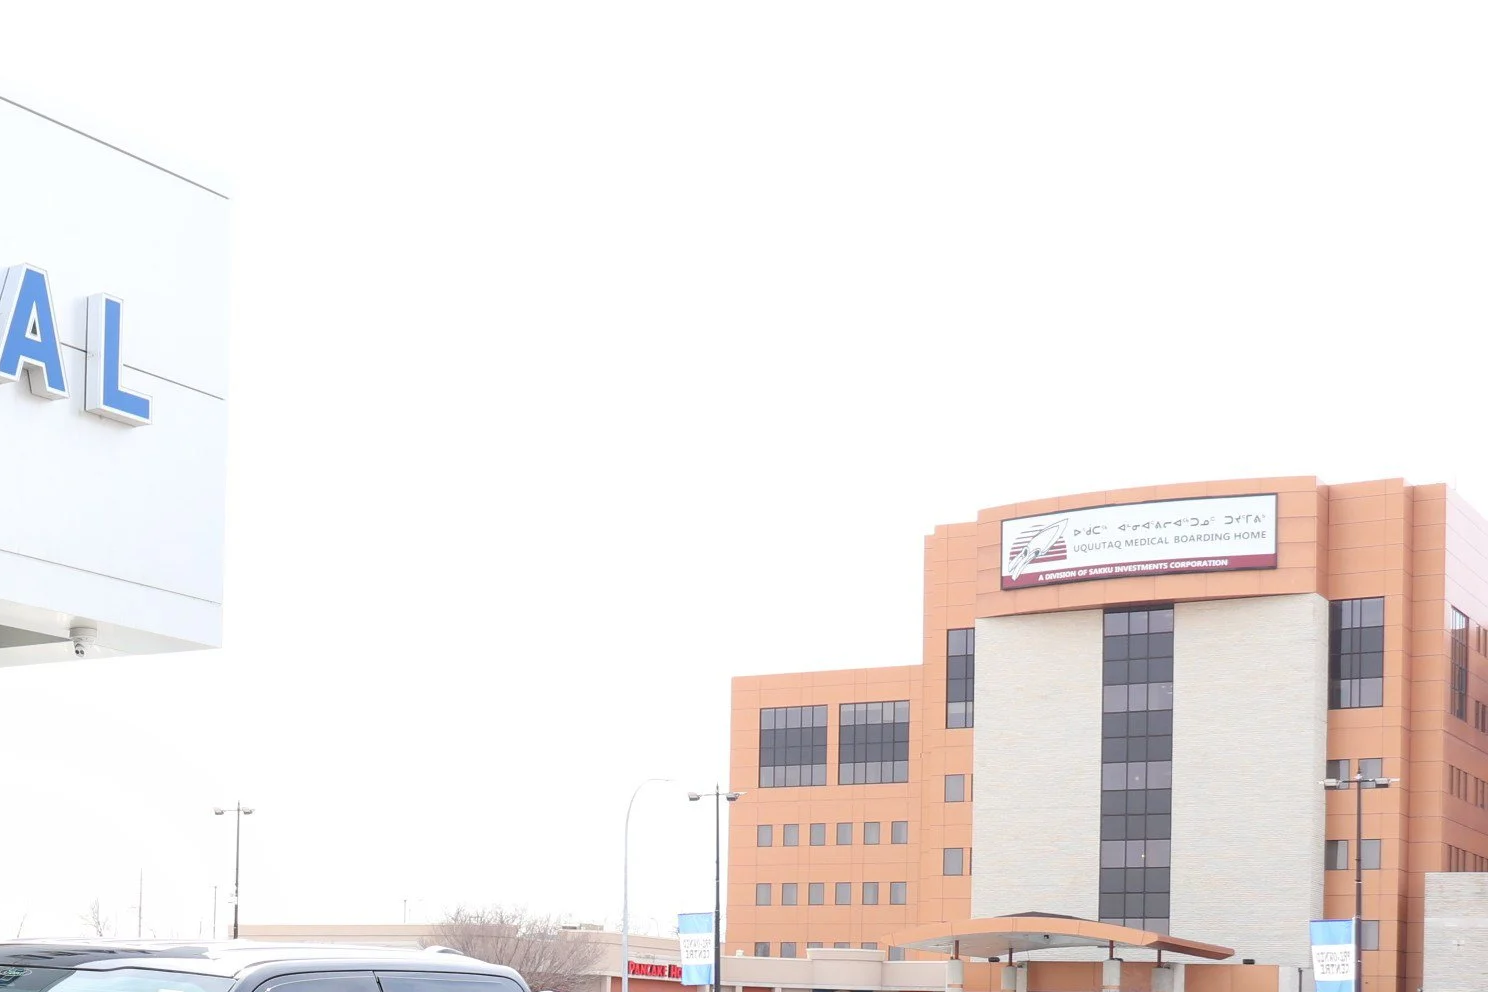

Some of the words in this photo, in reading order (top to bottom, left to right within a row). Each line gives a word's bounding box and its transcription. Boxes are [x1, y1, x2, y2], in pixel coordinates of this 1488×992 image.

[1073, 540, 1122, 553] UQUUTAQ
[1124, 537, 1169, 548] MEDICAL
[1173, 532, 1231, 543] BOARDING
[1234, 530, 1267, 540] HOME
[1045, 570, 1076, 580] DIVISION
[1077, 569, 1087, 577] OF
[1088, 566, 1114, 576] SAKKU
[1114, 562, 1168, 573] INVESTMENTS
[1169, 559, 1228, 569] CORPORATION
[628, 960, 668, 977] PANCAKE
